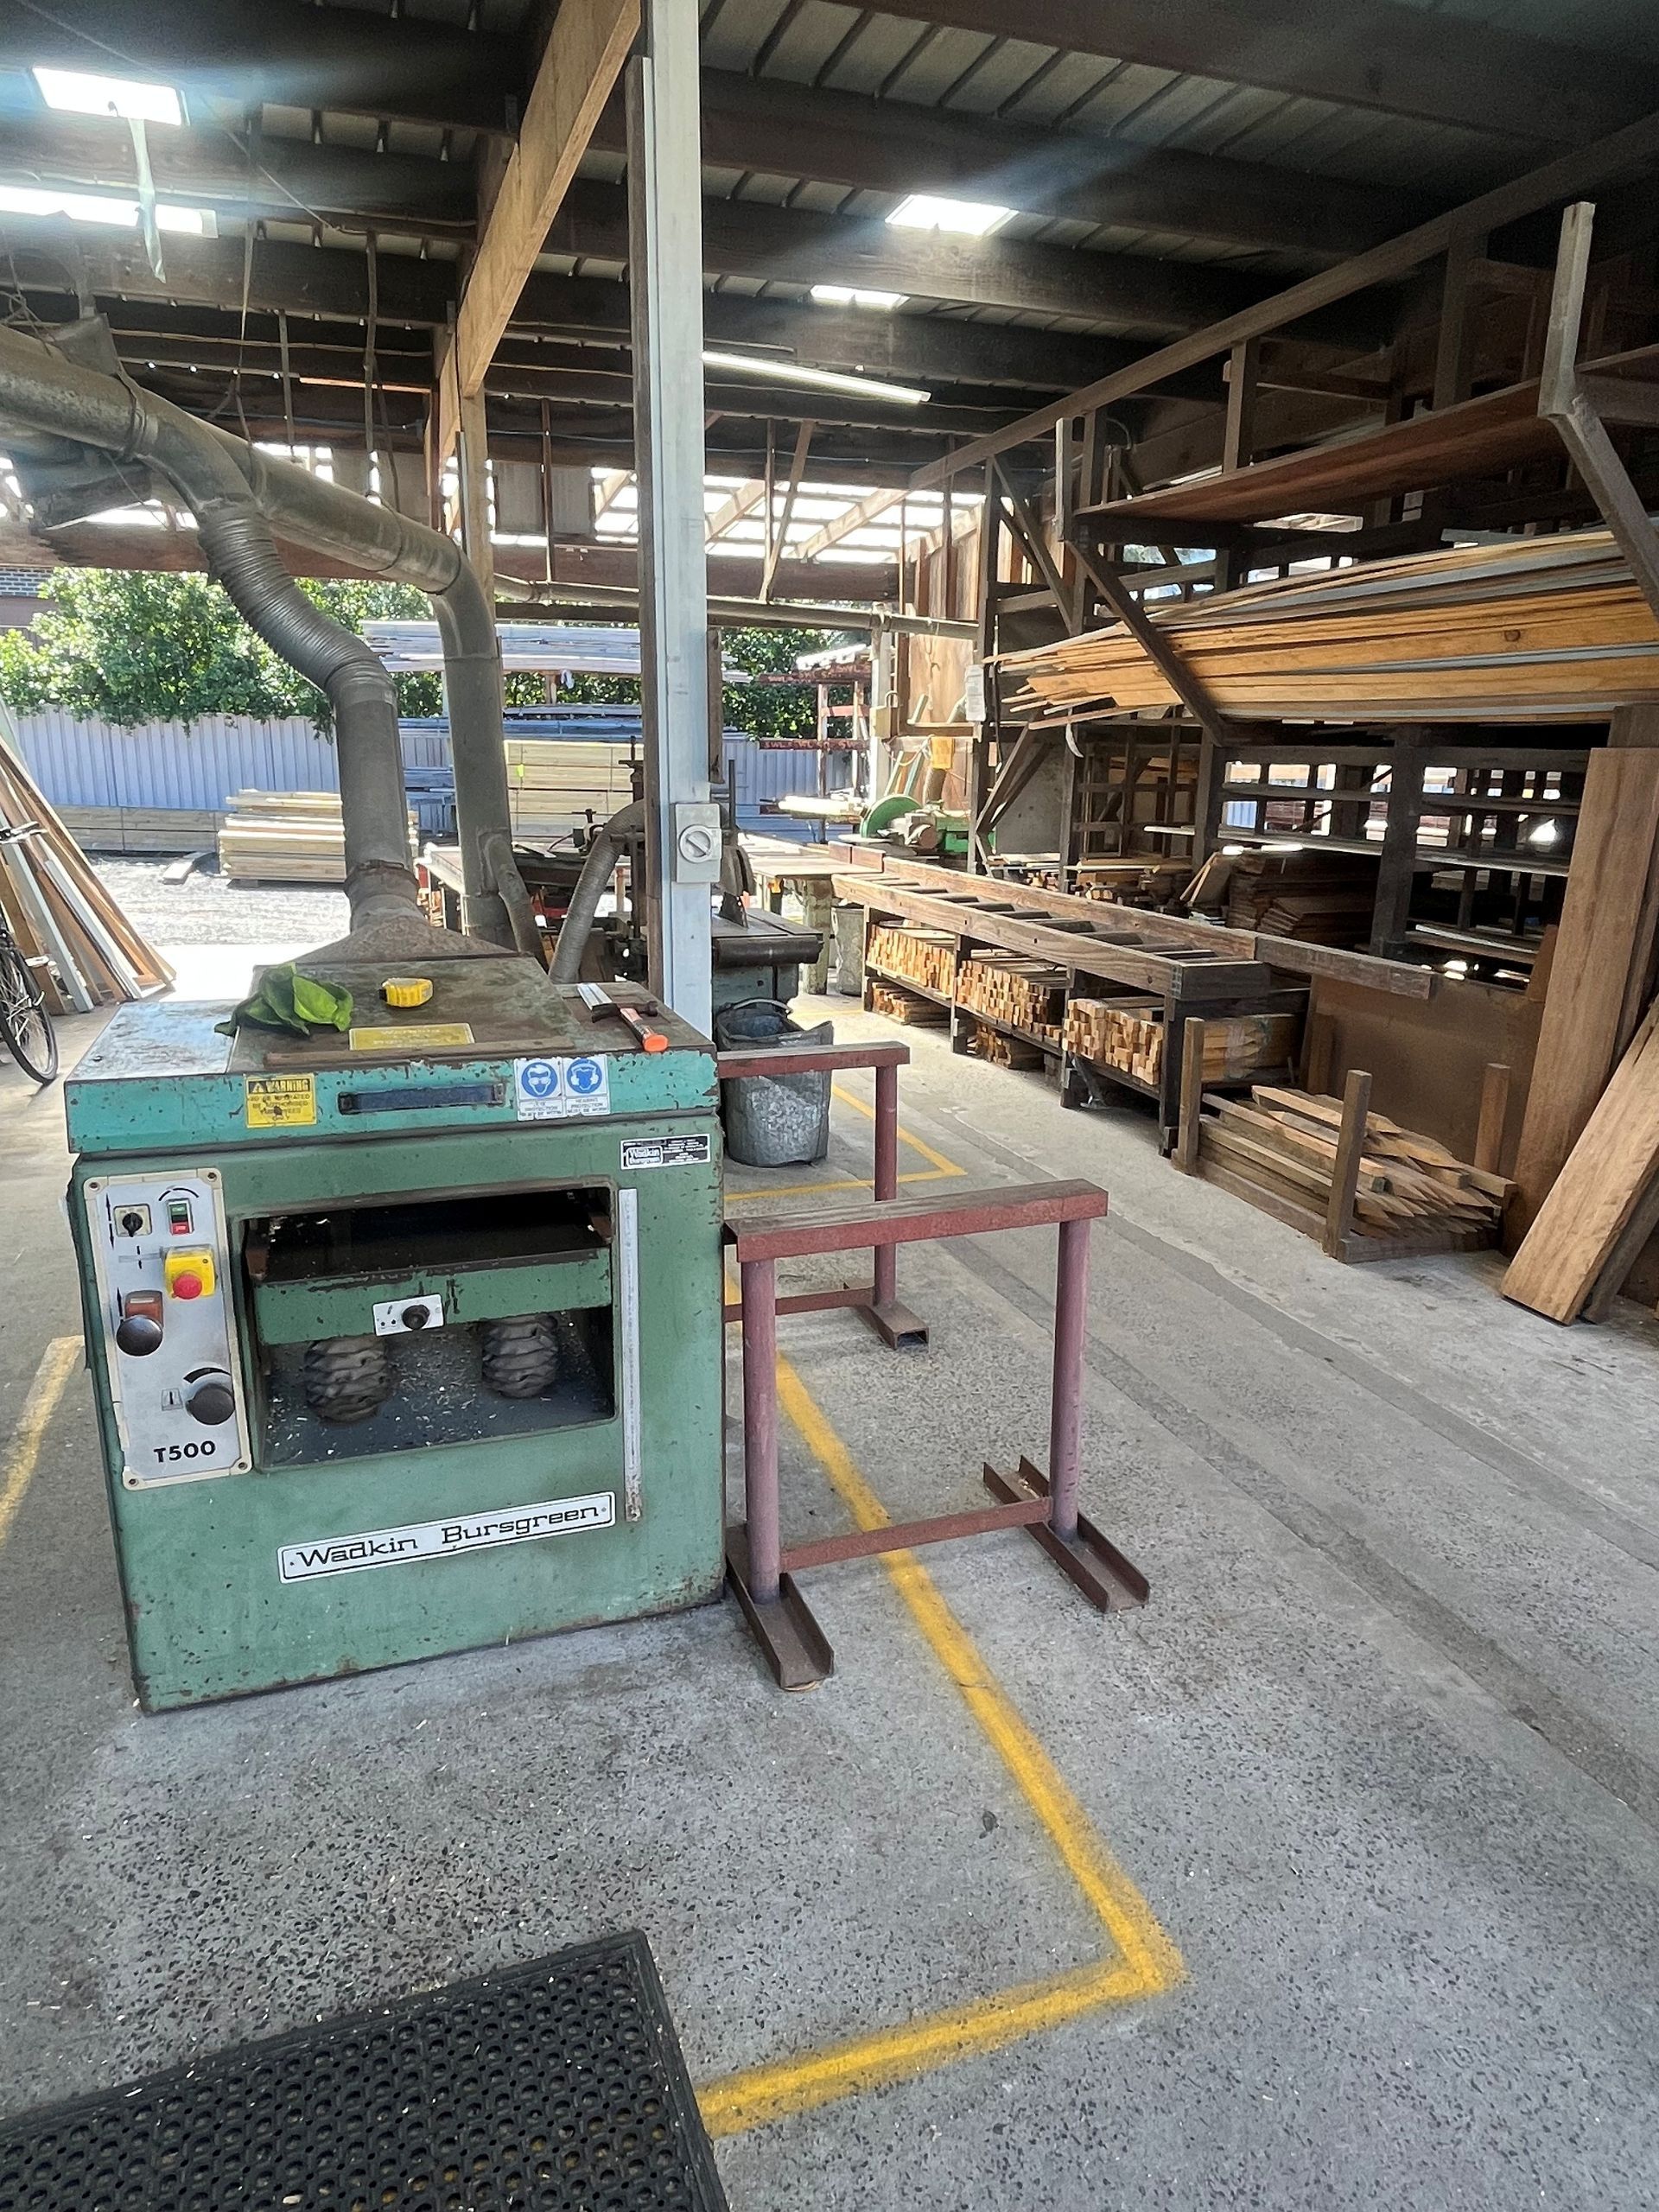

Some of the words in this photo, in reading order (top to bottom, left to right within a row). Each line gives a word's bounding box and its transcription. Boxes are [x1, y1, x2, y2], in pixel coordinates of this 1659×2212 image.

[266, 1079, 308, 1093] WARNING
[154, 1440, 216, 1463] T500
[296, 1537, 418, 1567] Wadkin
[441, 1506, 600, 1544] Bursgreen
